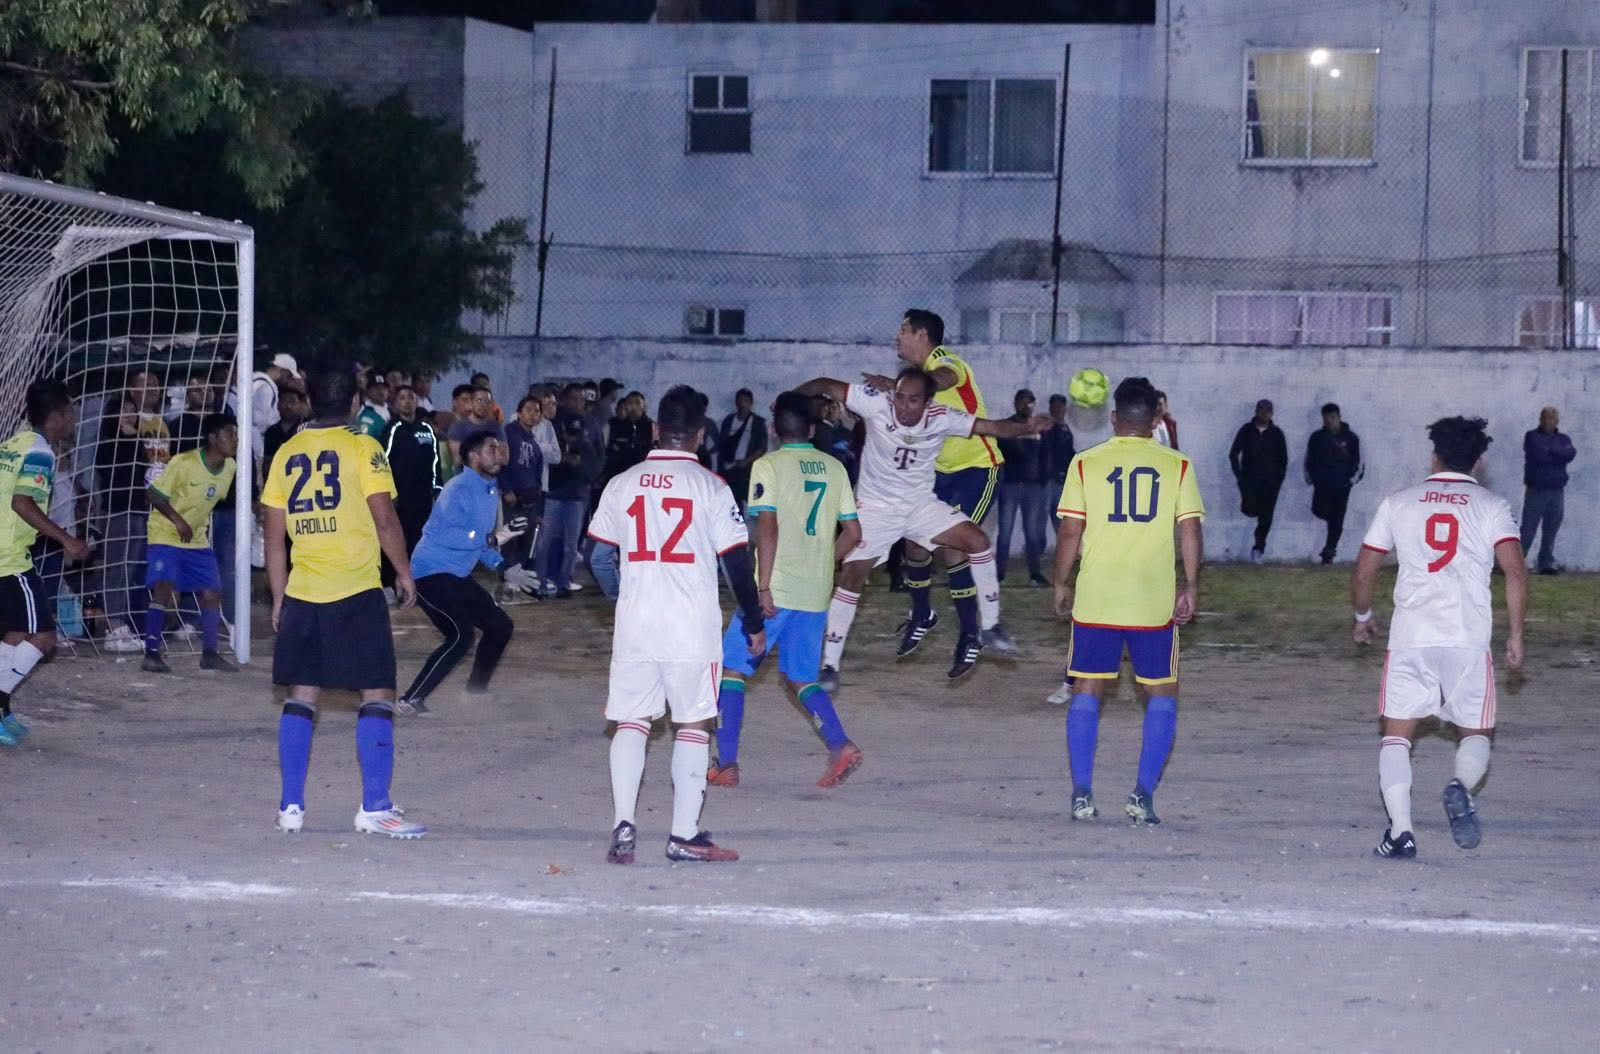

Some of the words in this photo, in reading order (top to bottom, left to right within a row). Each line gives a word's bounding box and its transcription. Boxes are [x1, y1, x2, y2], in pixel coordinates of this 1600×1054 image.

[285, 450, 341, 515] 23
[639, 473, 674, 489] GUS
[804, 480, 827, 536] 7
[1106, 466, 1161, 523] 10
[1418, 491, 1470, 506] JAMES
[295, 516, 337, 536] ARDILLO
[626, 495, 695, 564] 12
[1424, 513, 1459, 573] 9
